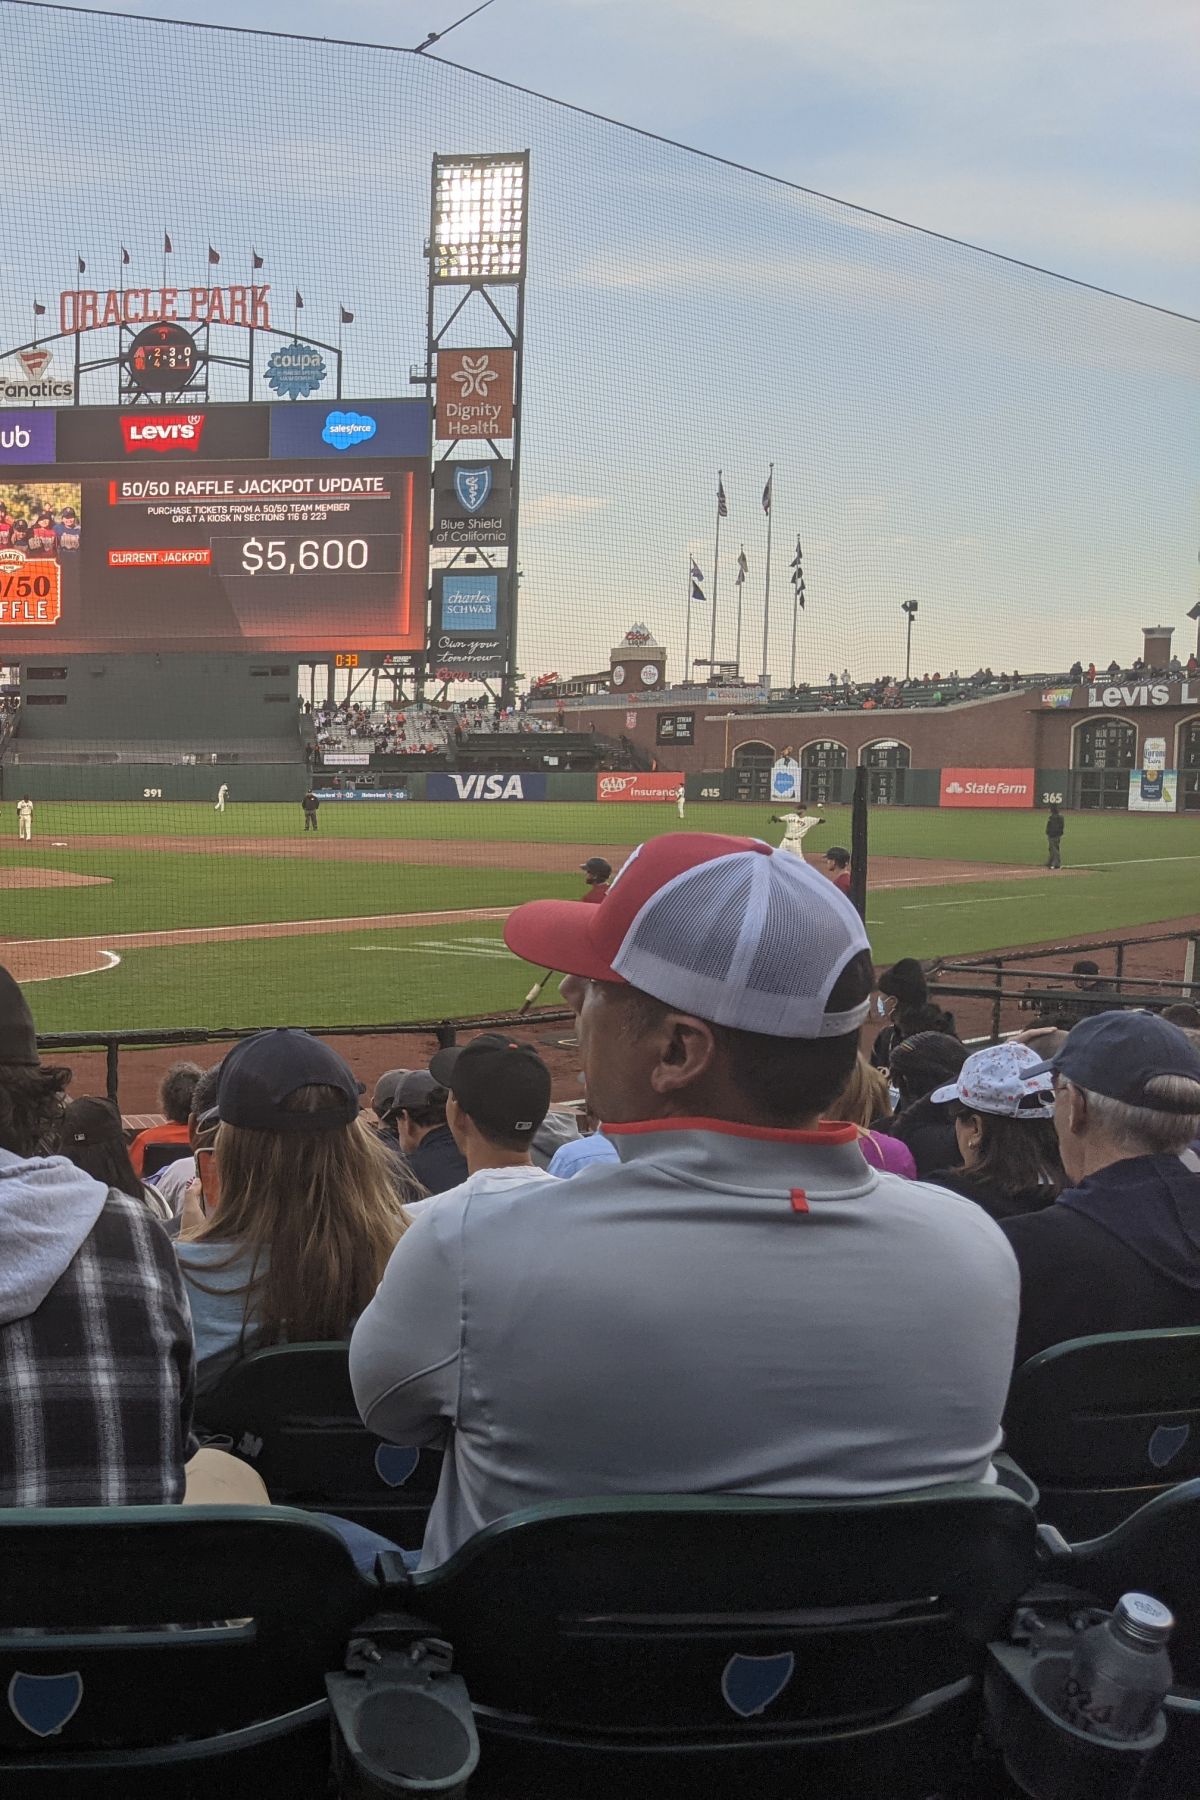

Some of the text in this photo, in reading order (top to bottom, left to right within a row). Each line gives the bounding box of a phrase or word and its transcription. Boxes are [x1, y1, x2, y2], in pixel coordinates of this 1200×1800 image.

[60, 285, 271, 335] ORACLE PARK
[154, 347, 161, 357] 2
[169, 347, 176, 357] 3
[184, 347, 191, 356] 0
[153, 358, 161, 367] 4
[169, 358, 176, 367] 3
[185, 358, 191, 367] 1
[273, 354, 320, 370] coupa
[446, 403, 502, 420] Dignity
[329, 423, 372, 434] salesforce
[122, 478, 384, 497] 50/50 RAFFLE JACKPOT UPDATE
[148, 503, 350, 515] PURCHASE TICKETS FROM A 50/50 TEAM MEMBER
[172, 515, 184, 523] OR
[185, 515, 196, 523] AT
[207, 514, 231, 522] KIOSK
[233, 514, 243, 522] IN
[245, 514, 285, 522] SECTIONS
[287, 513, 300, 521] 116
[302, 513, 309, 521] &
[310, 512, 327, 521] 223
[441, 518, 502, 530] Blue Shield
[437, 531, 507, 542] of California
[111, 552, 209, 563] CURRENT JACKPOT
[241, 537, 369, 575] $5,600
[448, 591, 491, 604] charles
[447, 604, 492, 614] SCHWAB
[438, 636, 500, 654] Own your
[336, 654, 358, 667] 0:33
[437, 651, 502, 663] tomorrow
[436, 667, 500, 680] Coors LIGHT
[448, 774, 524, 799] VISA
[700, 788, 720, 797] 415
[143, 789, 162, 797] 391
[1042, 793, 1063, 803] 365
